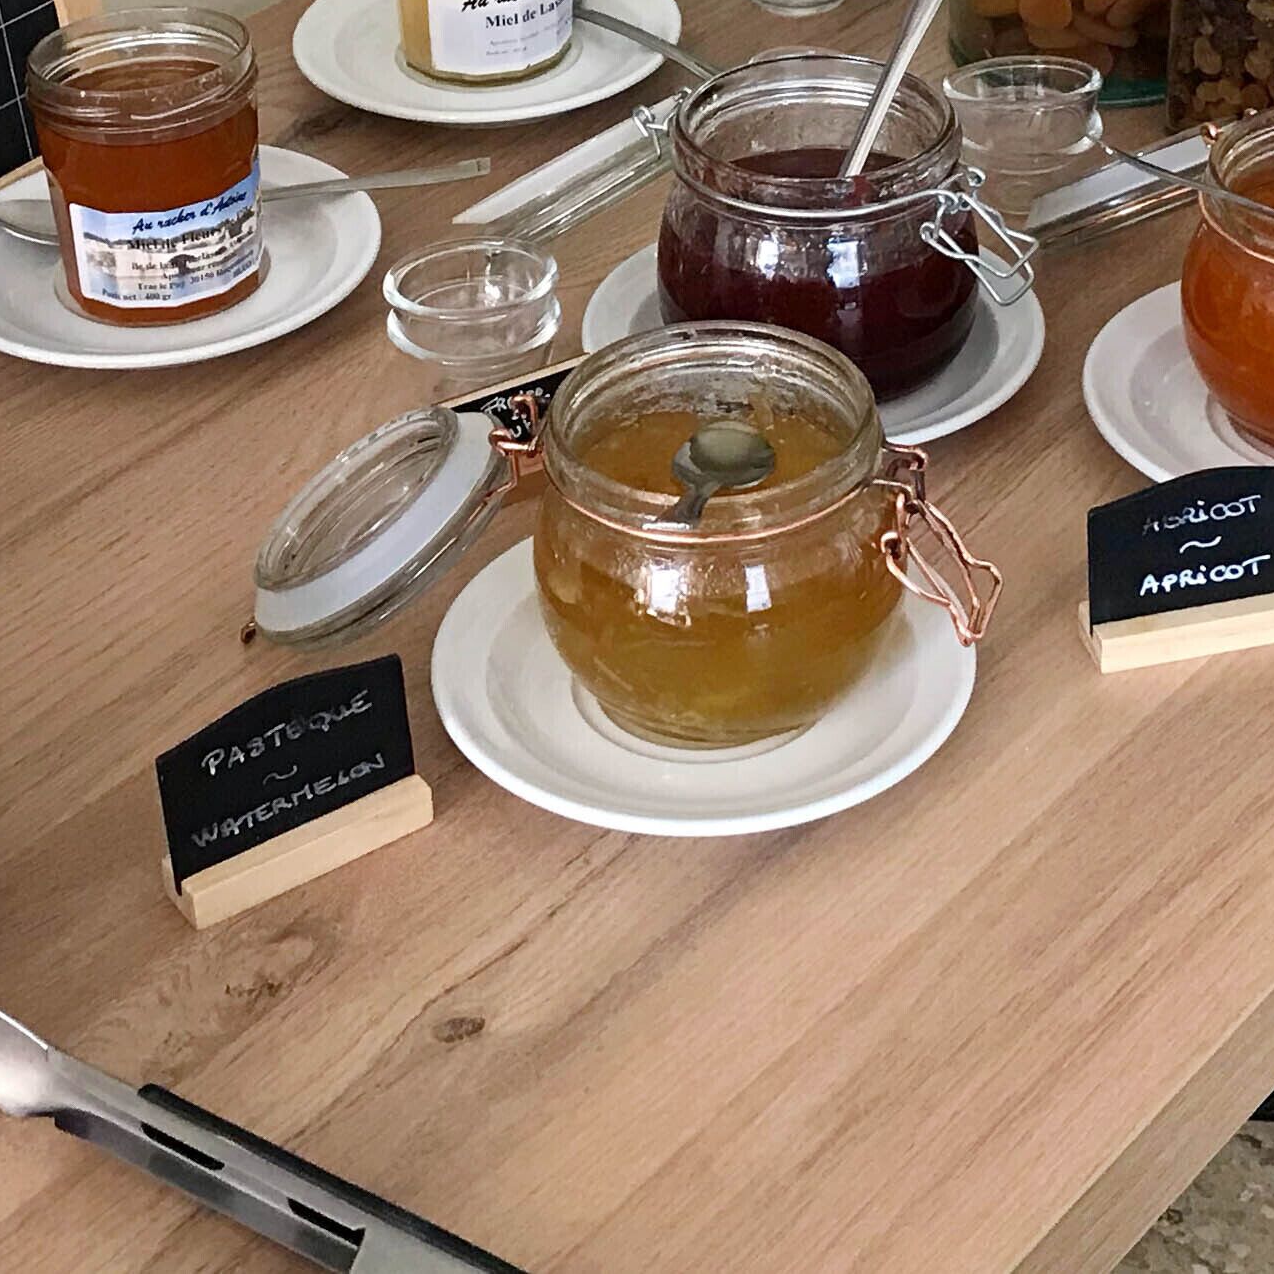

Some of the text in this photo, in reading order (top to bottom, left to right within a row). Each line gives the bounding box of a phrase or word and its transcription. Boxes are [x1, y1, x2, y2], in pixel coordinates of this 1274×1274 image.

[486, 8, 537, 28] Miel de
[132, 217, 154, 235] Au
[191, 752, 386, 847] WATERMELON
